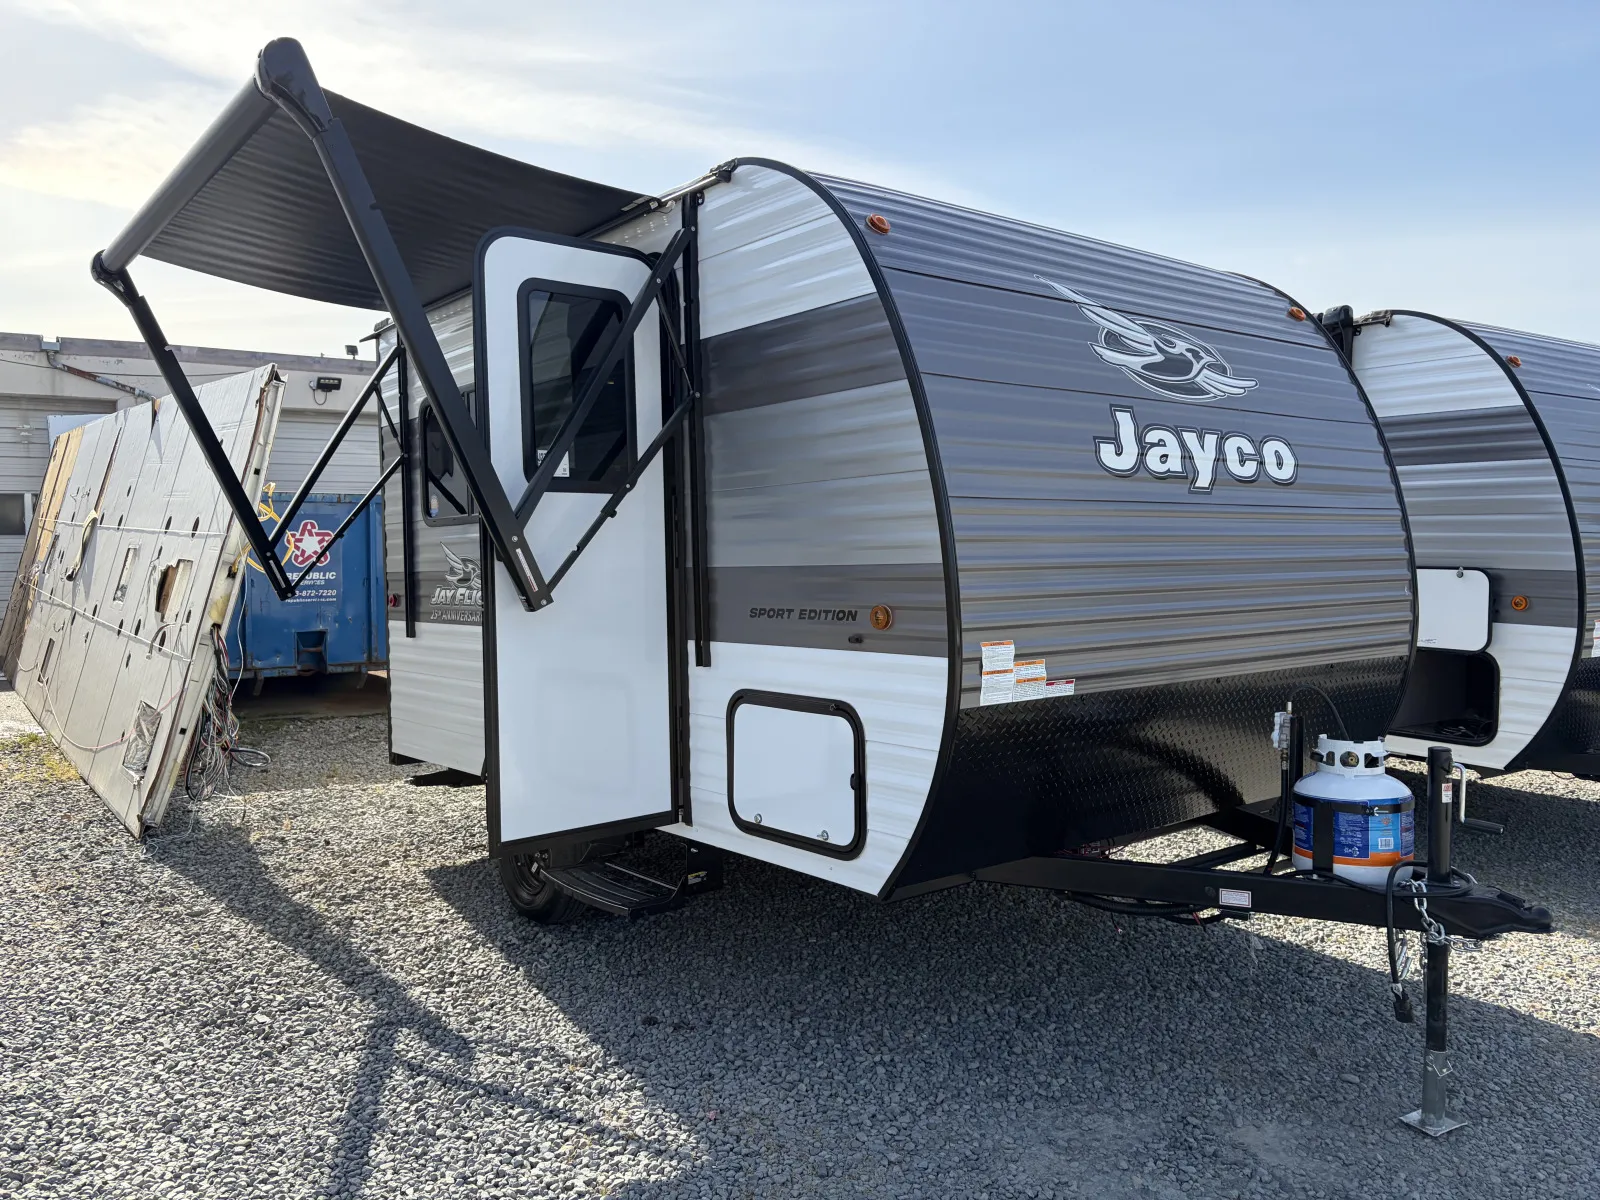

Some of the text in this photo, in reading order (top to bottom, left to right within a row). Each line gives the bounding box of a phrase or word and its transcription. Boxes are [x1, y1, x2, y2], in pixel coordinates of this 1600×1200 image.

[1093, 403, 1298, 494] Jayco
[286, 571, 336, 580] REUBLIC
[430, 586, 455, 605] JAY
[442, 610, 482, 622] ANNIVERSAR
[749, 607, 858, 622] SPORT EDITION
